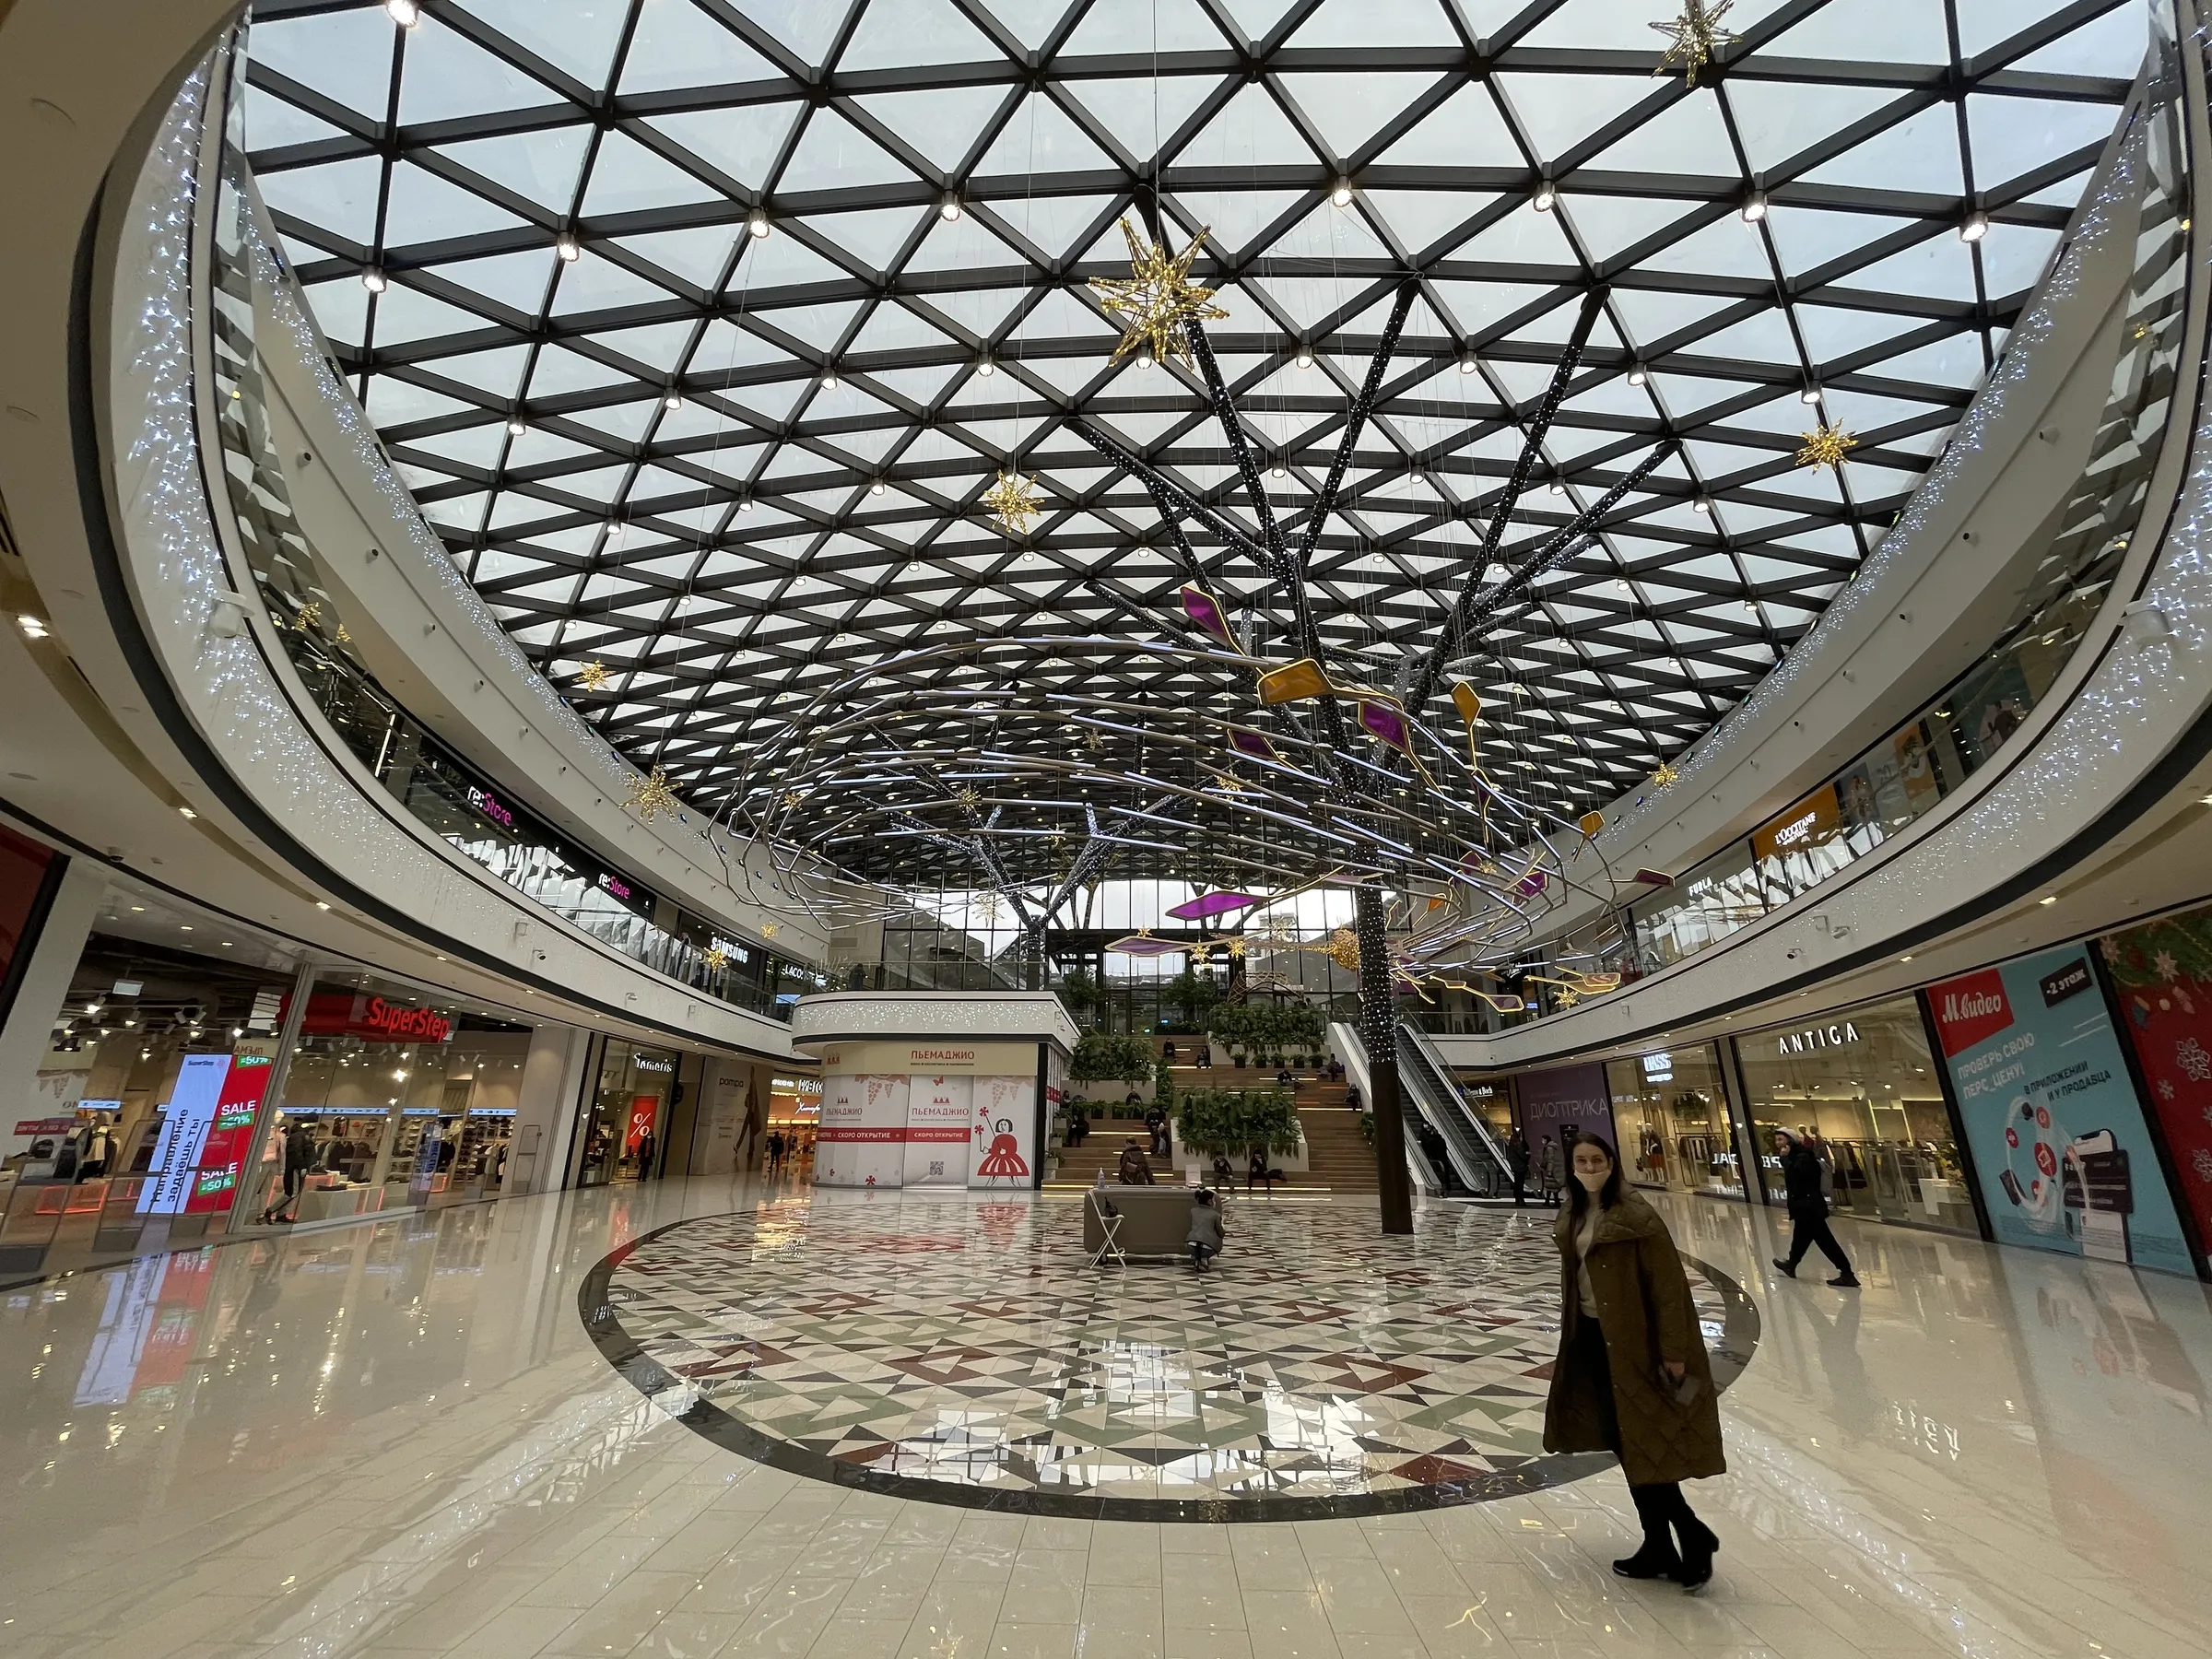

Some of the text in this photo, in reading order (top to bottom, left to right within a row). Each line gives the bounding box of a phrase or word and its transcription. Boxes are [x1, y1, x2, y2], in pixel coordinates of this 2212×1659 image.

[467, 786, 512, 826] re:Store
[599, 873, 630, 900] re:Store
[1688, 877, 1713, 898] FURLA
[711, 936, 748, 964] SAMSUNG
[2058, 969, 2087, 991] этаж
[369, 996, 451, 1043] SuperStep
[1942, 992, 2002, 1024] М.видео
[1779, 1022, 1859, 1054] ANTIGA
[911, 1050, 975, 1060] ПЬЕМАДЖИО
[1957, 1032, 2035, 1080] ПРОВЕРЬ СВОЮ
[718, 1077, 745, 1088] pampa
[2023, 1060, 2089, 1095] В ПРИЛОЖЕНИИ
[2047, 1070, 2112, 1102] И У ПРОДАВЦА
[220, 1100, 257, 1116] SALE
[825, 1107, 863, 1116] ПЬЕМАДЖИО
[912, 1107, 970, 1116] ПЬЕМАДЖИО
[1529, 1098, 1609, 1122] ДИОПТРИКА
[187, 1118, 201, 1139] ты
